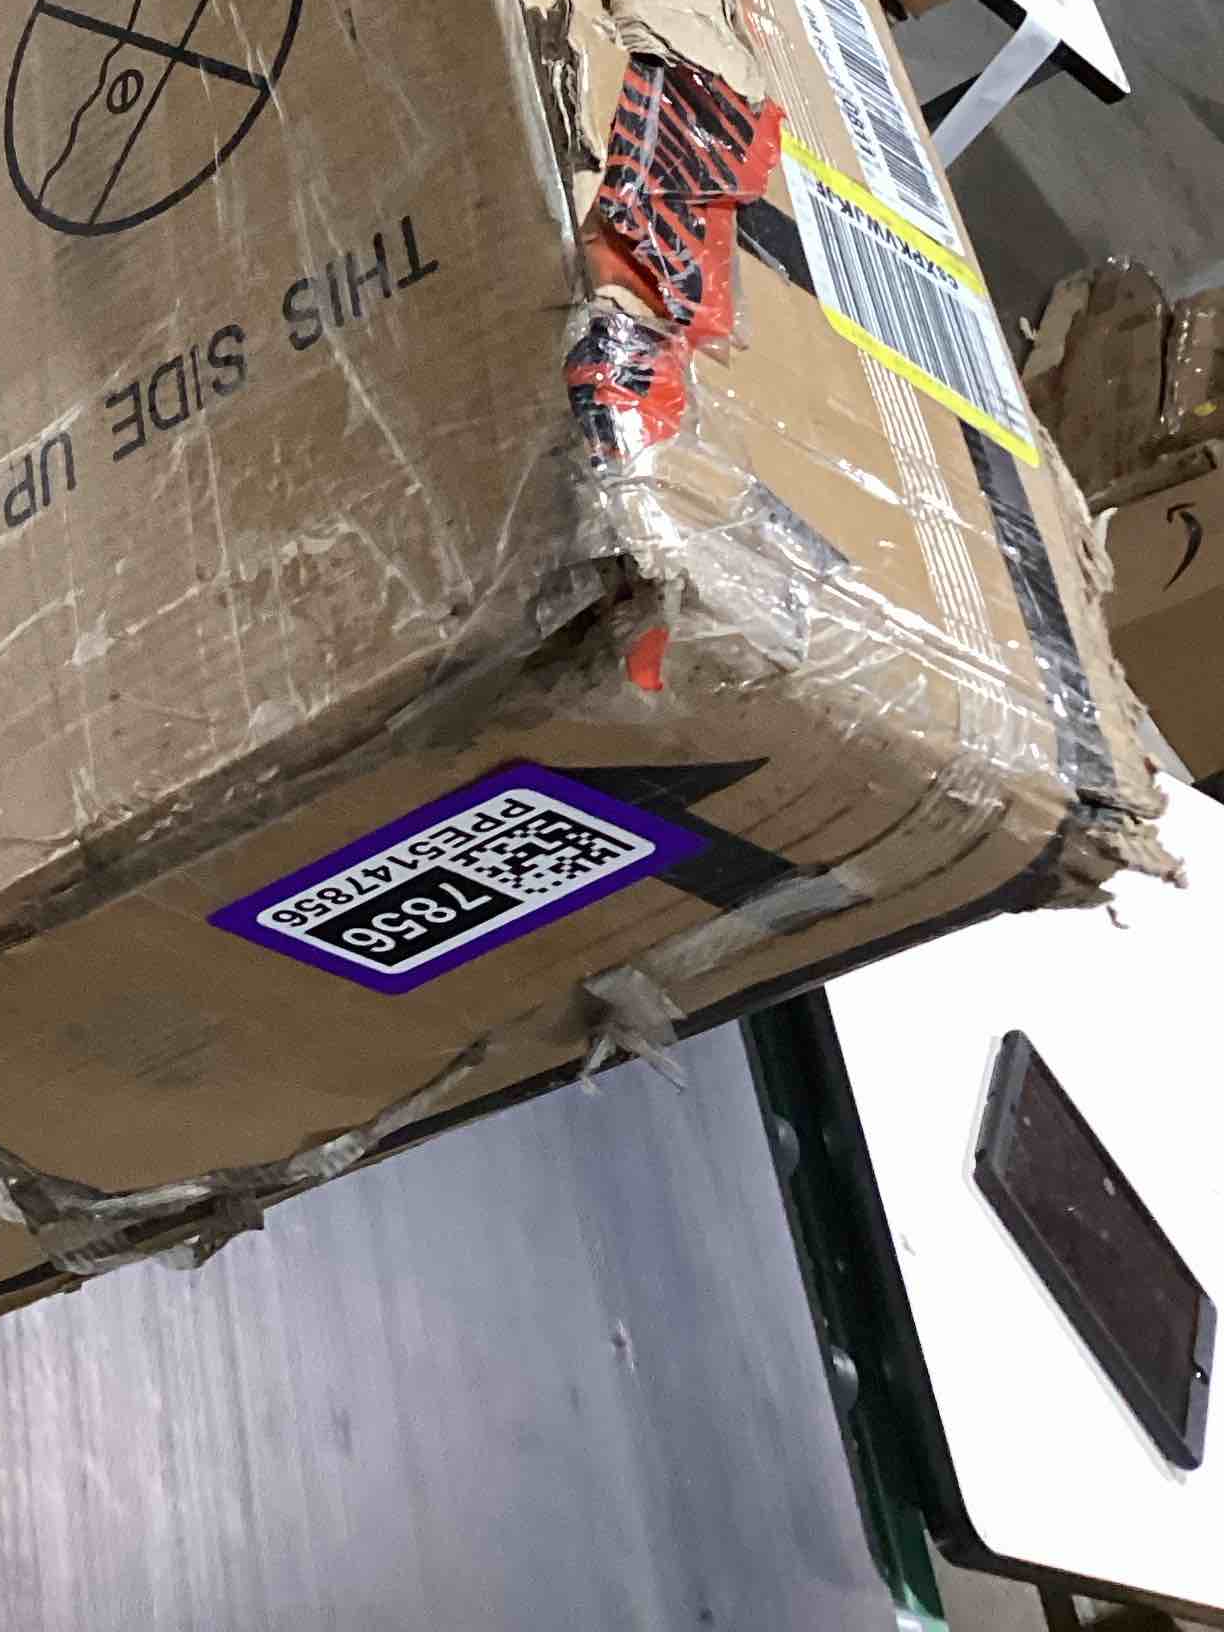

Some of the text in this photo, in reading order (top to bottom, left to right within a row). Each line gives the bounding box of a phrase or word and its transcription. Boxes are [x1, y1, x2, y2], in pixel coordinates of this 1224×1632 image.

[283, 215, 440, 352] THIS
[106, 323, 249, 464] SIDE
[4, 432, 77, 529] UP
[272, 798, 536, 928] PPE5147856
[341, 881, 494, 953] 7856
